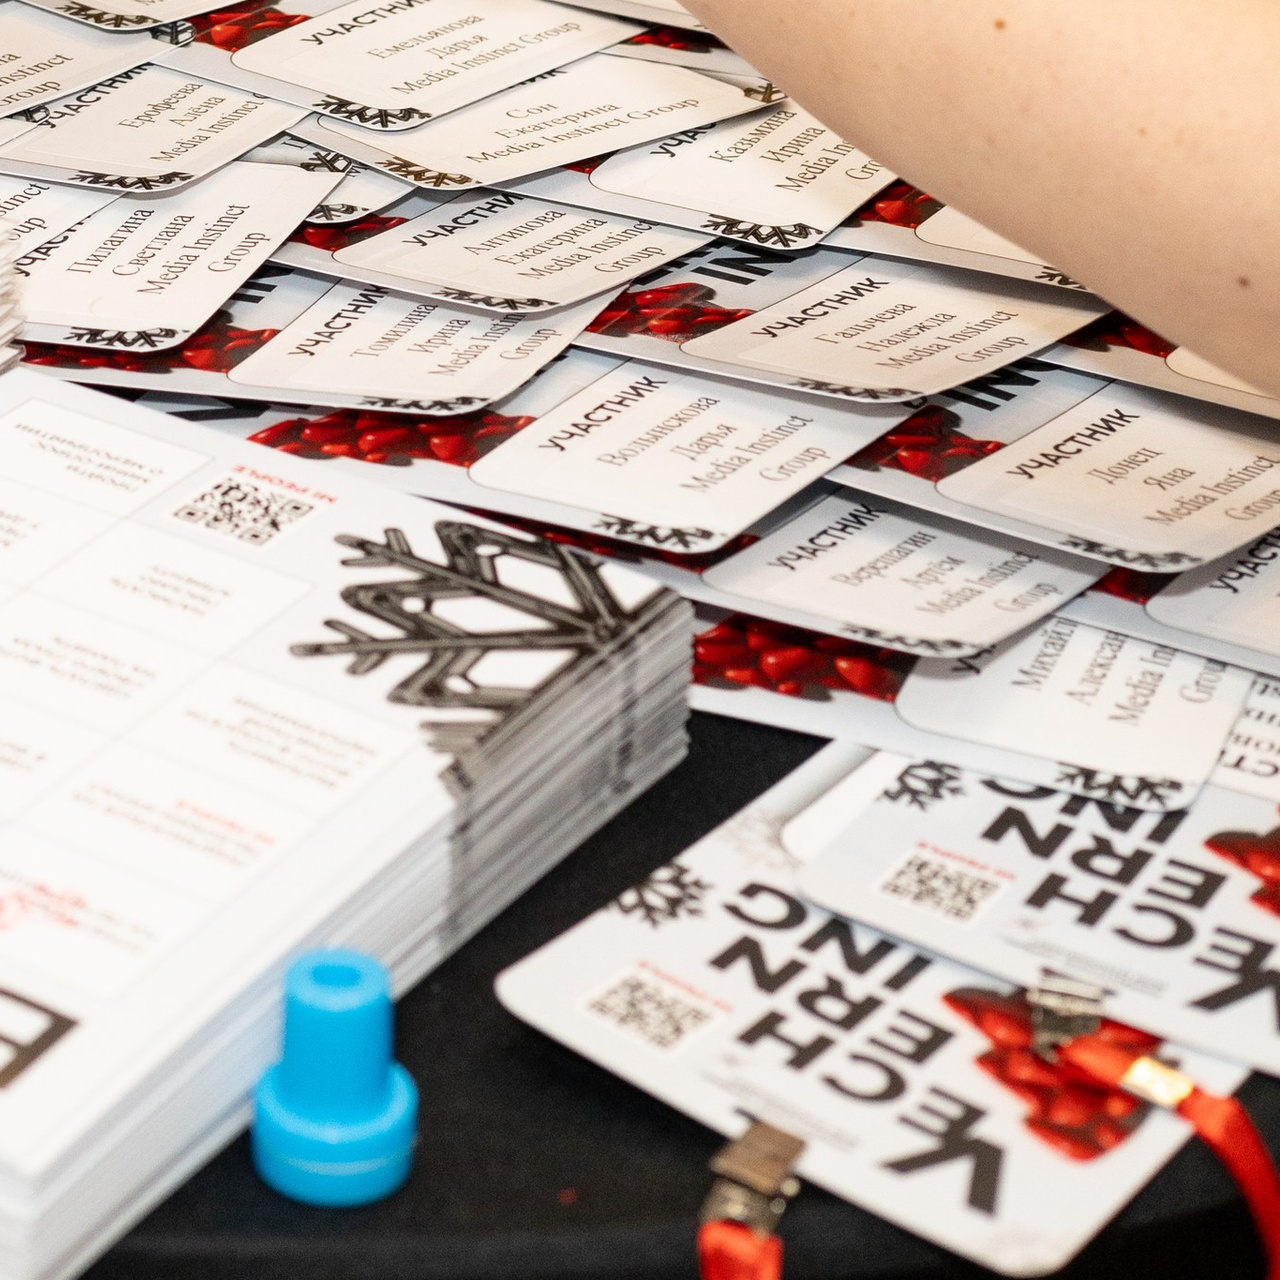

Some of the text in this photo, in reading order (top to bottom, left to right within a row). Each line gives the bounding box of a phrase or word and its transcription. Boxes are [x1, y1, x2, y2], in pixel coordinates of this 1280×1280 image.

[367, 14, 486, 61] Емельянова
[391, 19, 583, 96] Media Instinct Group
[426, 33, 489, 61] Дарья
[117, 81, 204, 130] Ерофеева
[149, 99, 266, 163] Media Instinct
[168, 94, 227, 128] Алёна
[465, 97, 700, 164] Media Instinct Group
[494, 103, 622, 139] Екатерина
[505, 102, 559, 120] Сон
[707, 108, 798, 163] Казьмина
[759, 124, 827, 164] Ирина
[775, 152, 840, 193] Media
[844, 159, 886, 181] Gro
[65, 207, 155, 274] Пилагина
[111, 213, 195, 276] Светлана
[403, 190, 526, 247] УЧАСТНИ
[462, 208, 567, 256] Антипова
[494, 216, 608, 266] Екатерина
[136, 203, 251, 295] Media Instinct
[207, 231, 272, 273] Group
[516, 218, 661, 280] Media Instinct
[593, 243, 667, 274] Group
[287, 283, 391, 357] УЧАСТНИК
[349, 302, 440, 358] Томилина
[750, 276, 892, 339] УЧАСТНИК
[856, 310, 958, 353] Надежда
[407, 317, 472, 355] Ирина
[427, 312, 528, 377] Media Instin
[499, 327, 563, 362] Group
[875, 308, 1020, 370] Media Instinct
[954, 334, 1030, 363] Group
[538, 375, 670, 452] УЧАСТНИК
[596, 395, 721, 467] Волынскова
[670, 422, 738, 462] Дарья
[680, 413, 815, 494] Media Instinct
[758, 445, 832, 482] Group
[1006, 408, 1142, 480] УЧАСТНИК
[1087, 447, 1166, 487] Донец
[1143, 466, 1198, 492] Яна
[1143, 453, 1280, 526] Media Instinct
[767, 502, 889, 571] УЧАСТНИК
[913, 549, 1042, 618] Media Instinct
[992, 581, 1065, 614] Group
[1011, 618, 1079, 692] Михайл
[1179, 658, 1229, 704] Grou
[980, 804, 1229, 911] ERN
[722, 880, 936, 993] ING
[708, 934, 957, 1066] ERN
